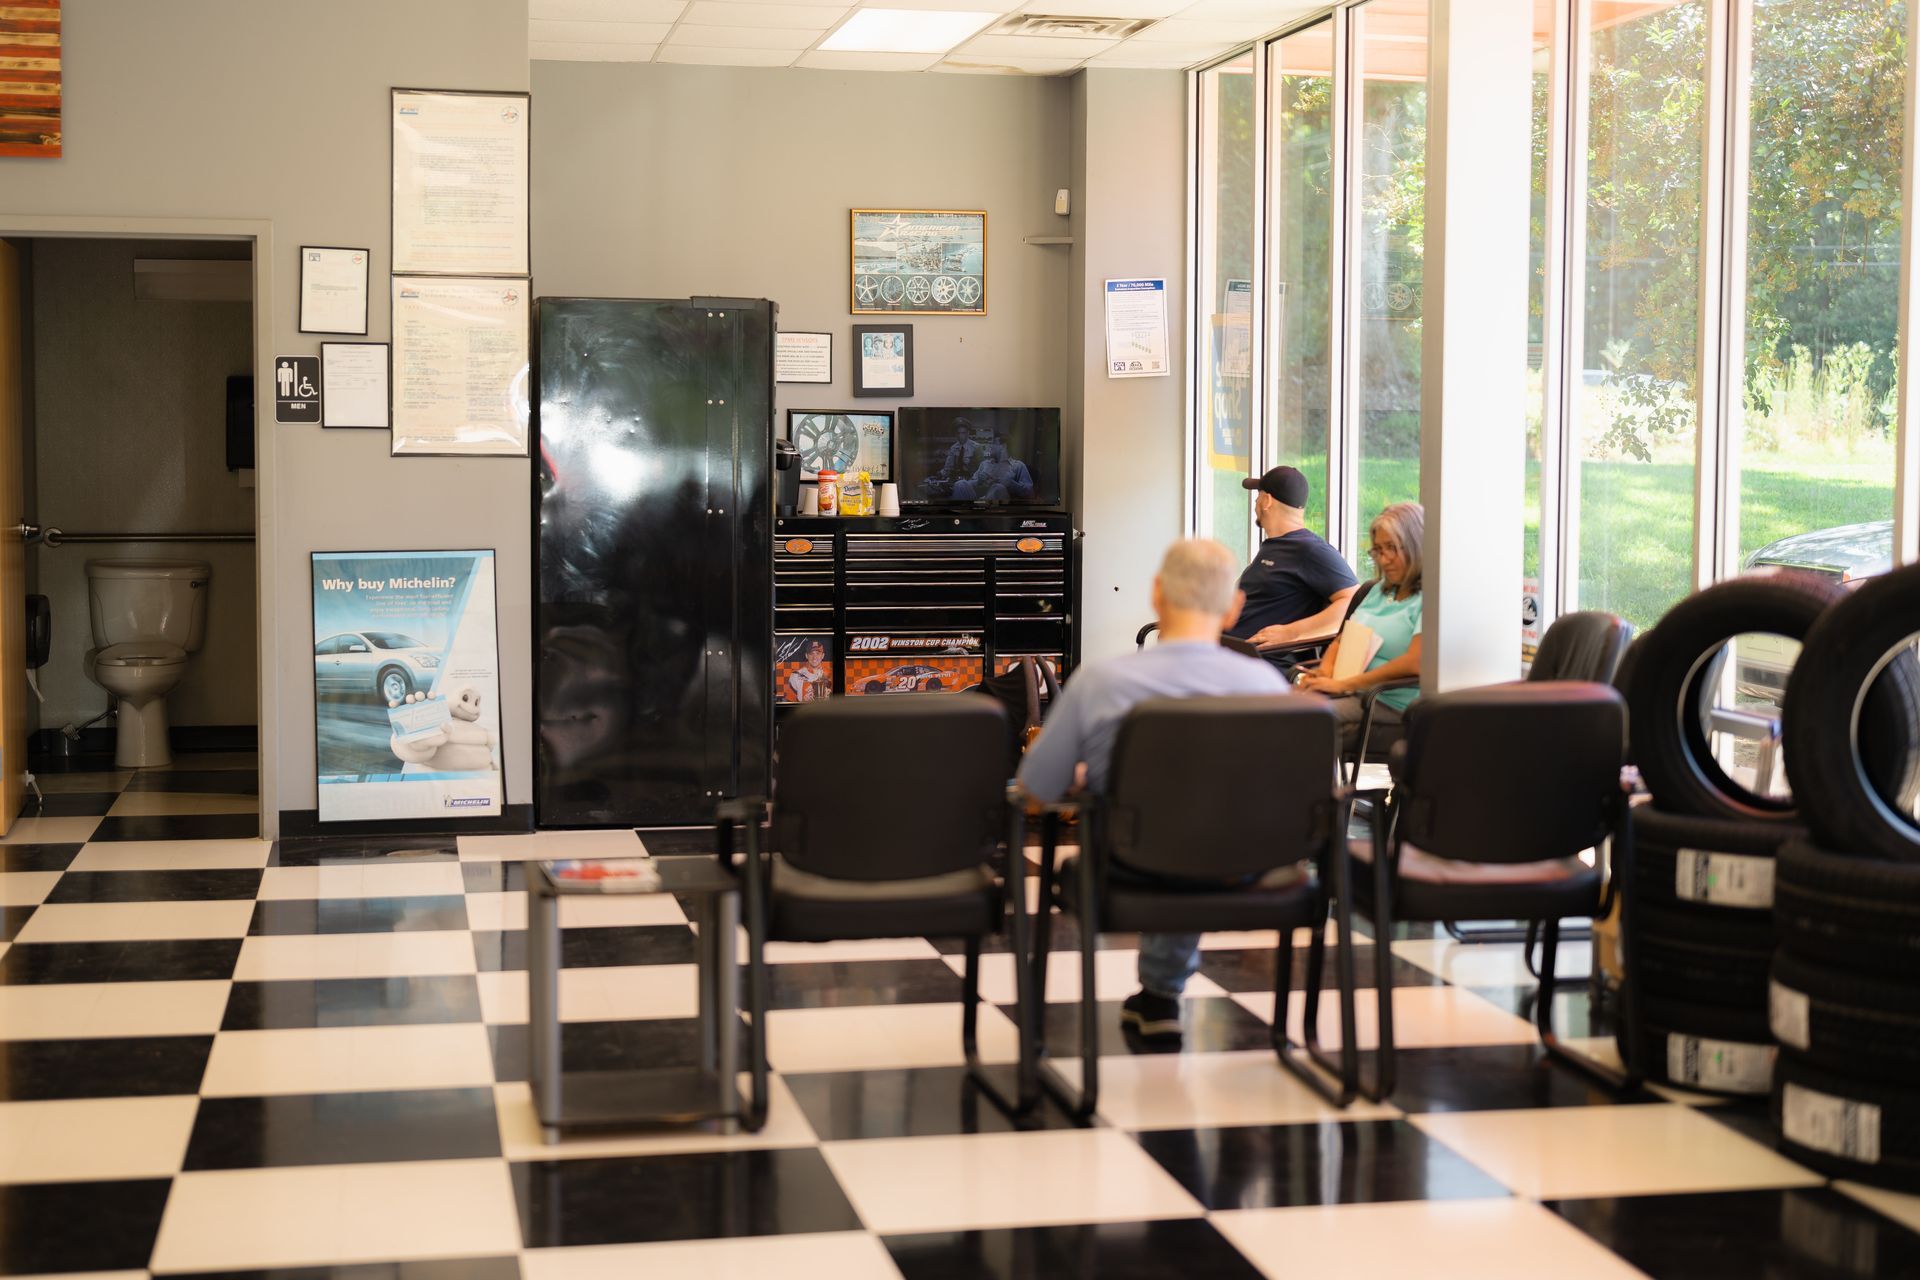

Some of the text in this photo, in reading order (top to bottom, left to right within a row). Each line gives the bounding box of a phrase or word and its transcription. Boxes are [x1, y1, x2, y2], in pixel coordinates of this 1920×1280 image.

[322, 576, 457, 592] Why buy Michelin?
[851, 637, 889, 649] 2002
[941, 638, 978, 646] CHAMPION
[898, 676, 917, 689] 20
